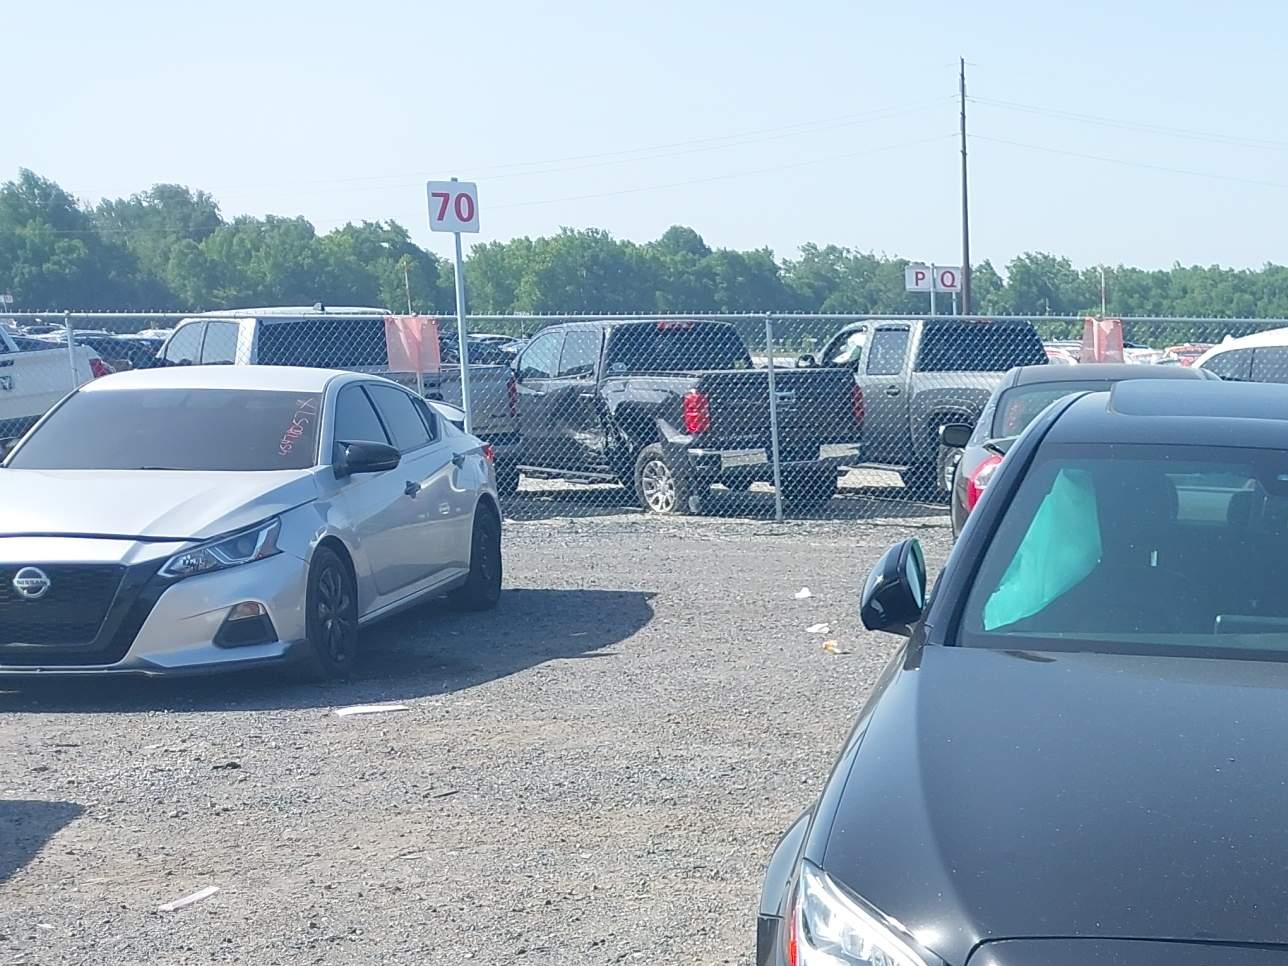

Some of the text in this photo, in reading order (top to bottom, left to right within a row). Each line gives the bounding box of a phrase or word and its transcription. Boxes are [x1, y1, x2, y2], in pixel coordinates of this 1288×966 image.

[431, 192, 475, 223] 70
[915, 271, 926, 287] P
[940, 270, 957, 288] Q
